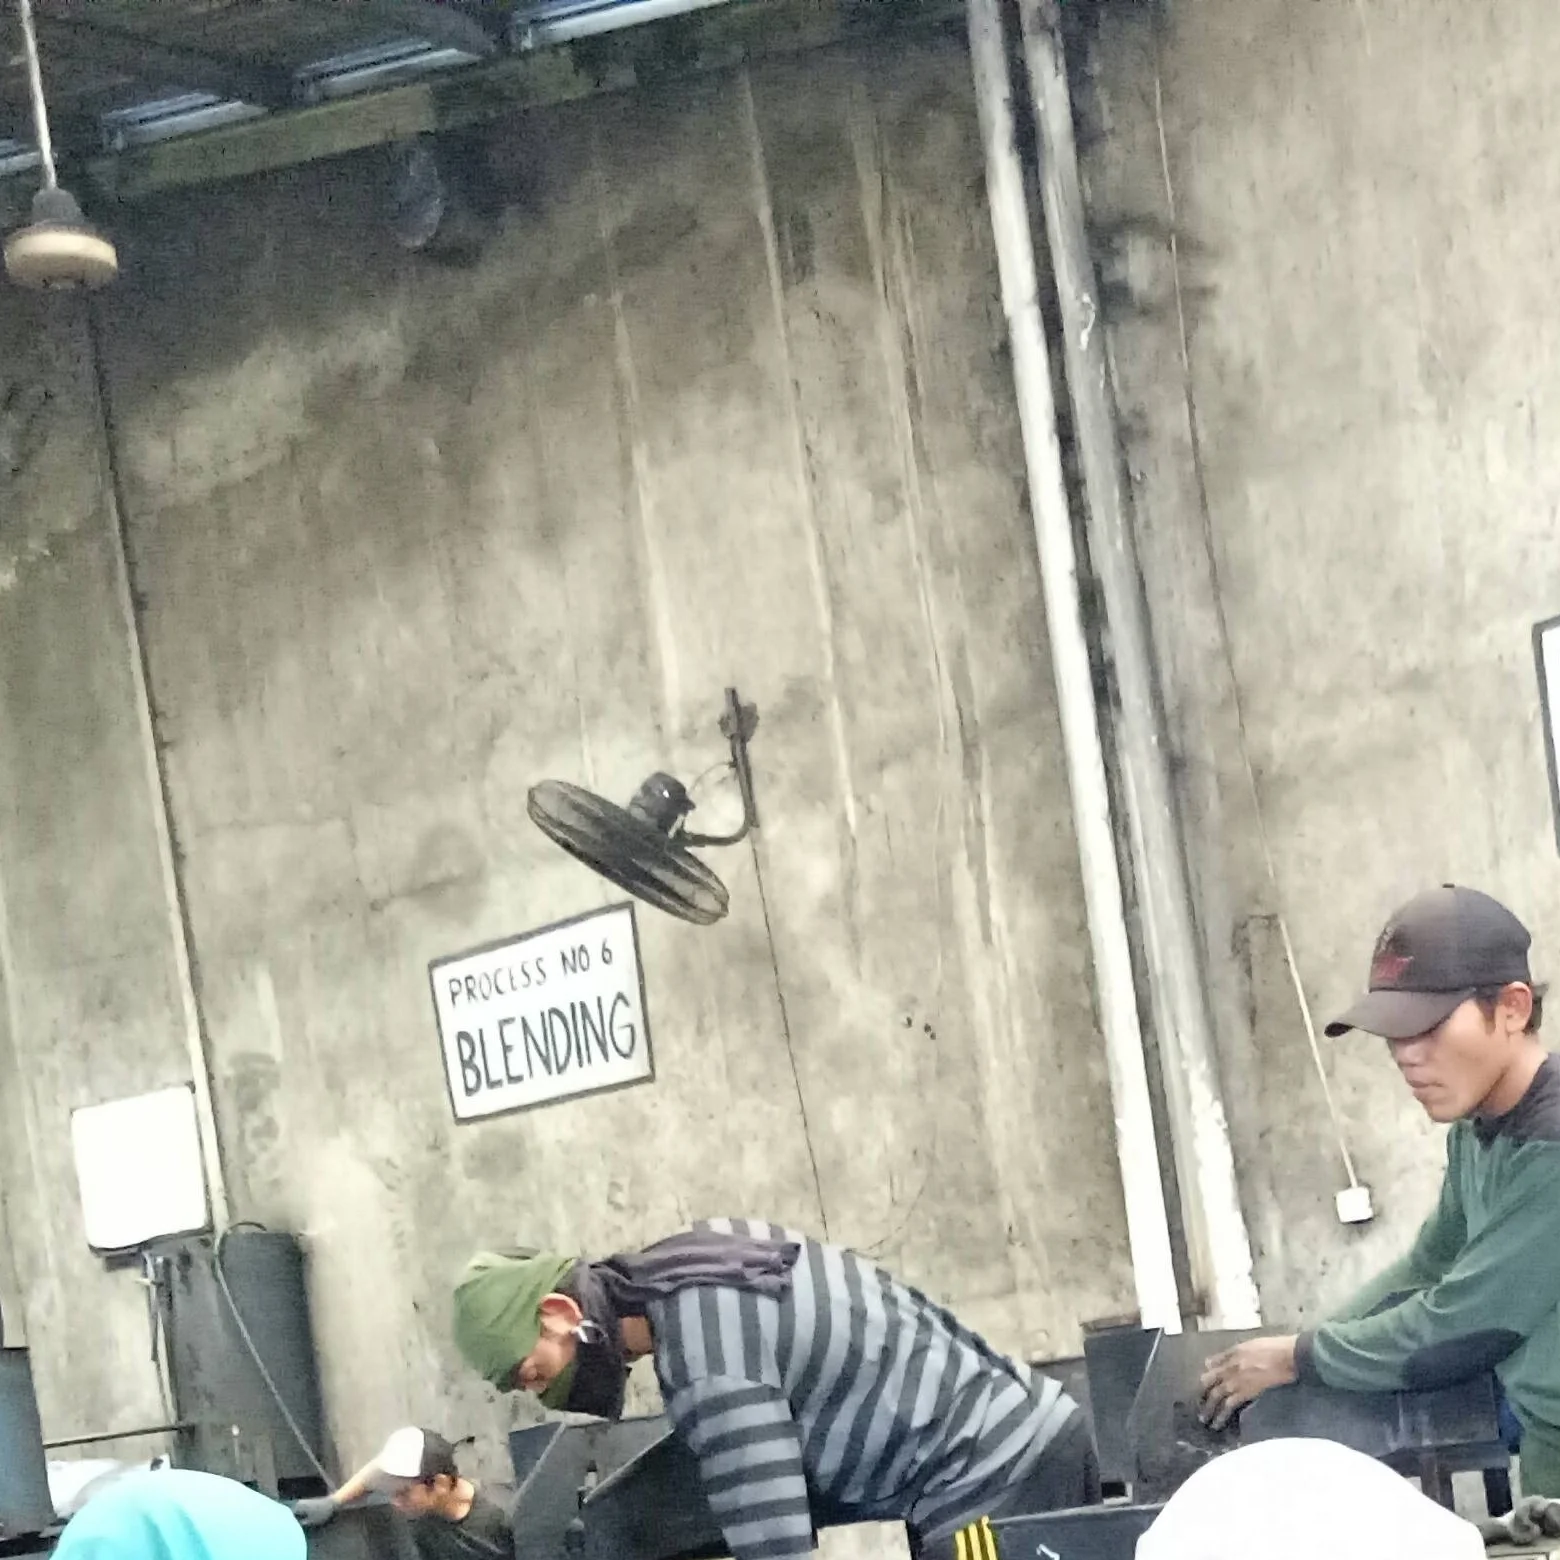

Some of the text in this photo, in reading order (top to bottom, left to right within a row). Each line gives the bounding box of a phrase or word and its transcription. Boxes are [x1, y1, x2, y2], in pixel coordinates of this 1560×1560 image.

[448, 938, 614, 1009] PROCESS NO 6
[455, 991, 637, 1097] BLENDING
